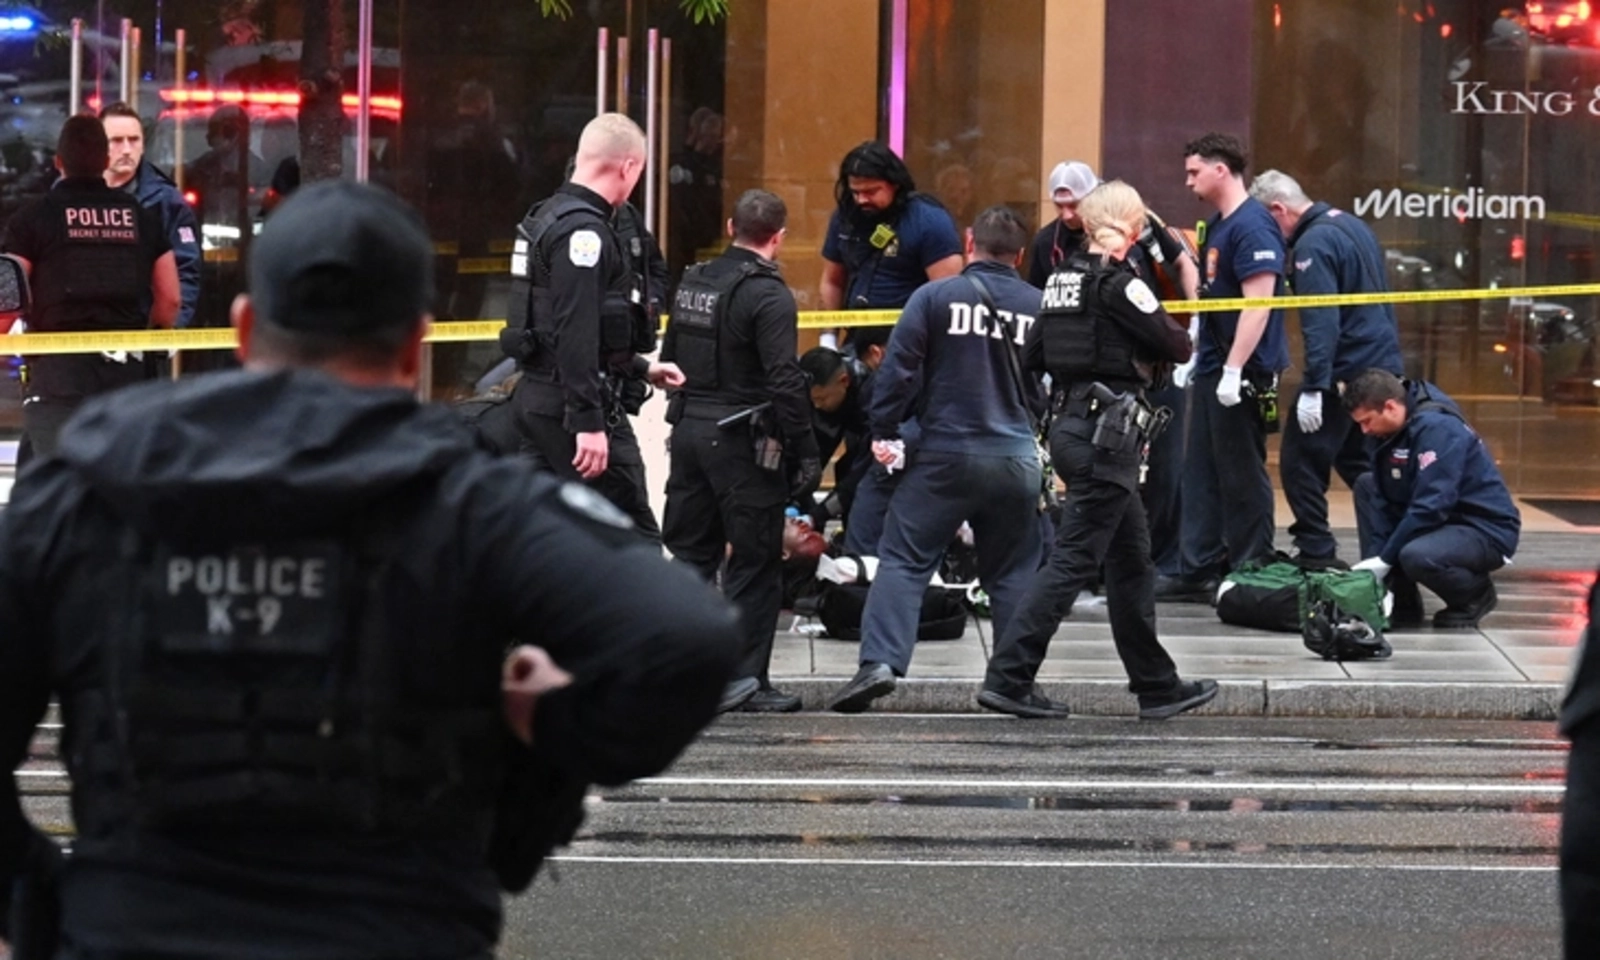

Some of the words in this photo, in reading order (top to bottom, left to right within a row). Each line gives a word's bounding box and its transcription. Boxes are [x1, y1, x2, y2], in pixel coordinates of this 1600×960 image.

[1353, 186, 1545, 219] Meridiam
[65, 207, 134, 227] POLICE
[68, 229, 99, 239] SECRET
[101, 229, 135, 239] SERVICE
[675, 289, 715, 313] POLICE
[1041, 284, 1081, 310] POLICE
[167, 556, 326, 597] POLICE
[207, 597, 282, 635] K-9
